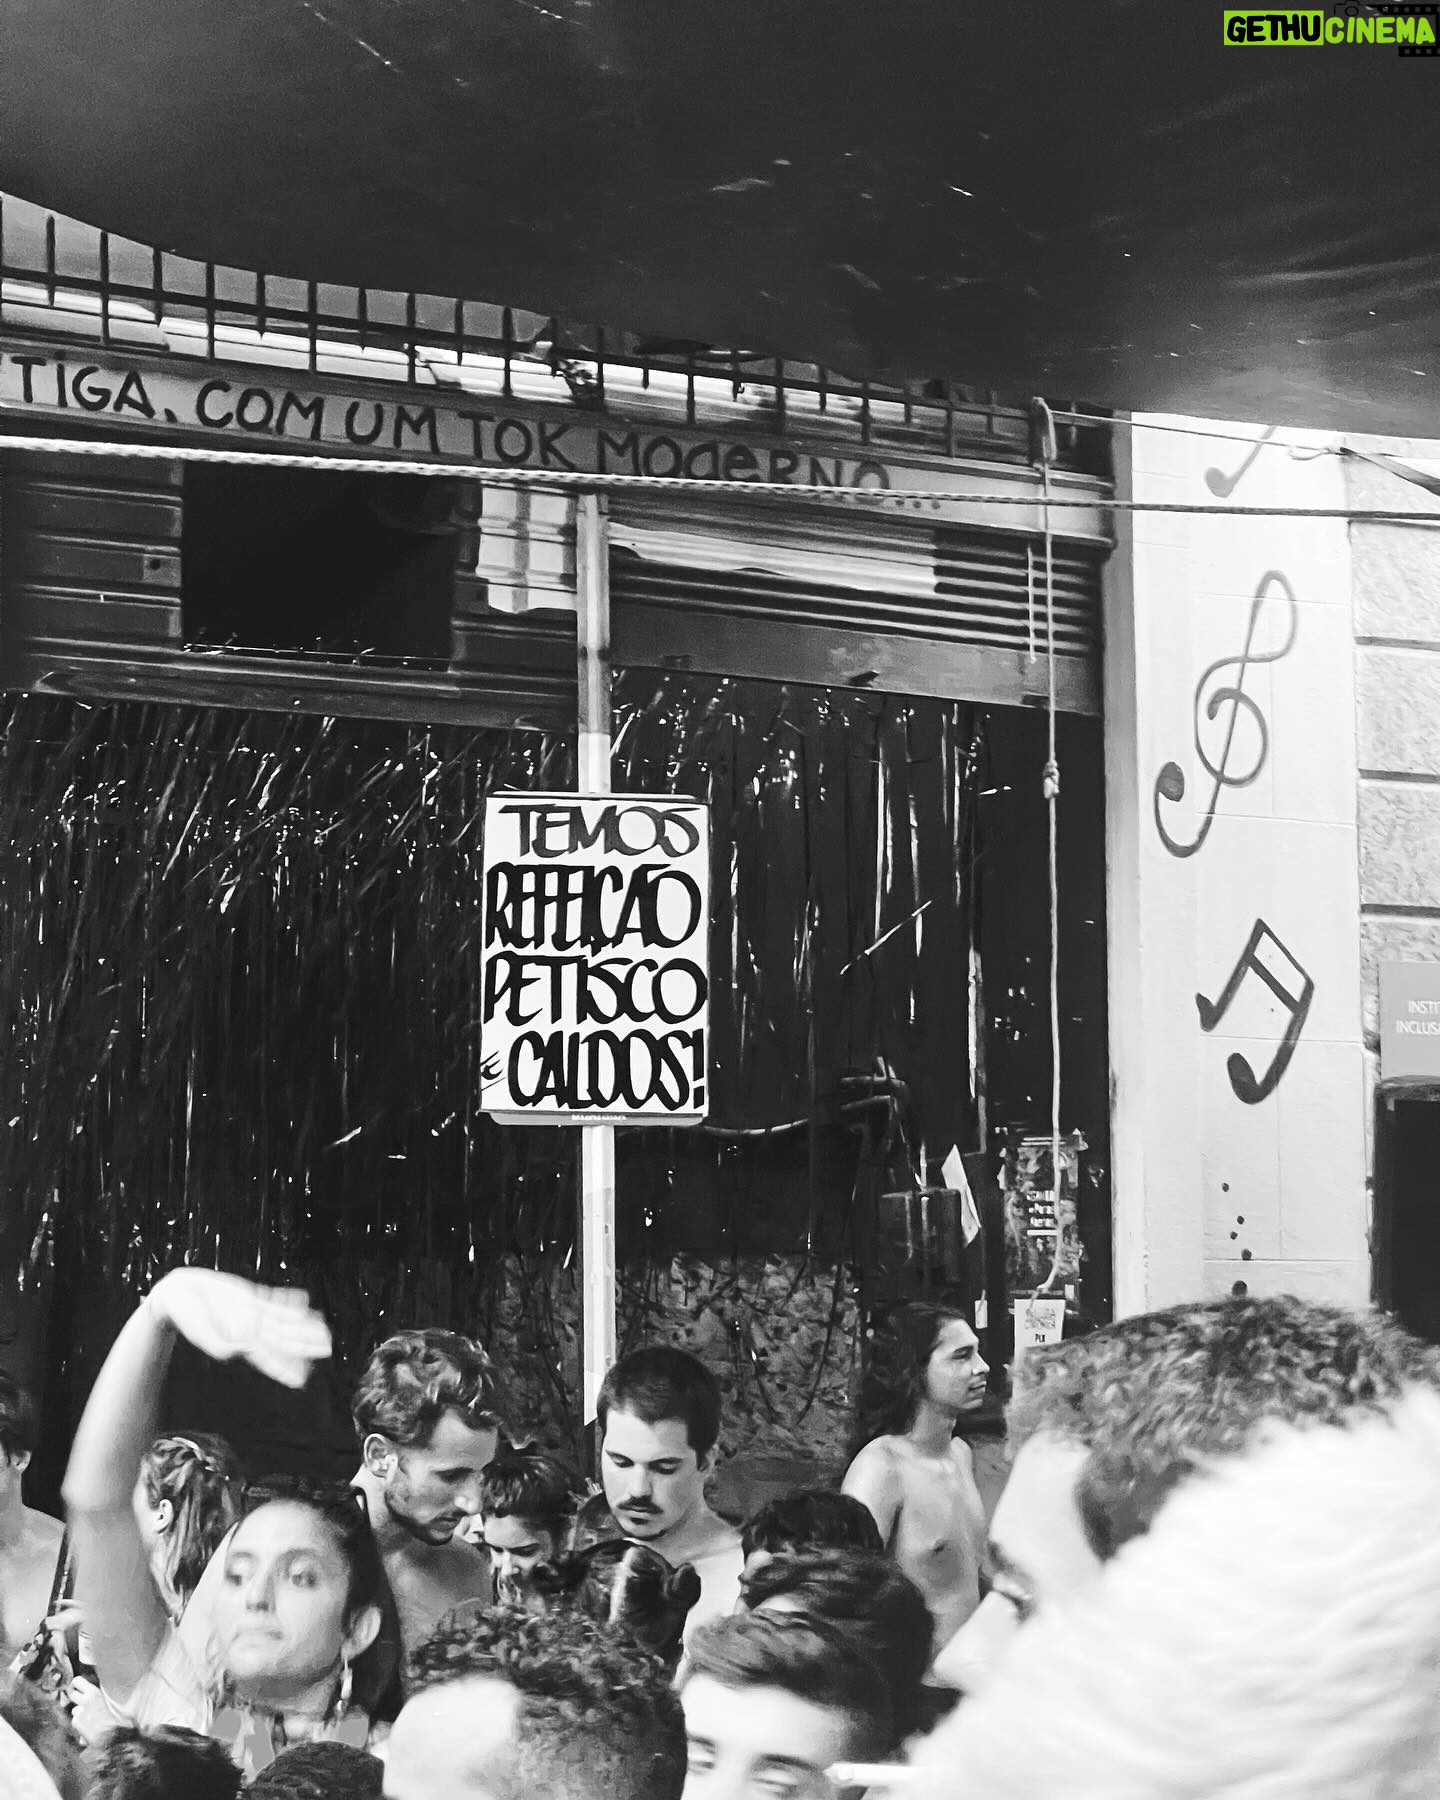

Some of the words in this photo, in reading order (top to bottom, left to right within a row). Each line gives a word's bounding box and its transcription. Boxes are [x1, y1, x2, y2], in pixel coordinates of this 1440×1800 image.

[197, 380, 325, 440] COM
[345, 401, 441, 454] UM
[458, 411, 576, 470] TOK
[499, 804, 700, 858] TEMOS
[484, 951, 708, 1026] PETISCO
[508, 1028, 704, 1111] CALDOS!
